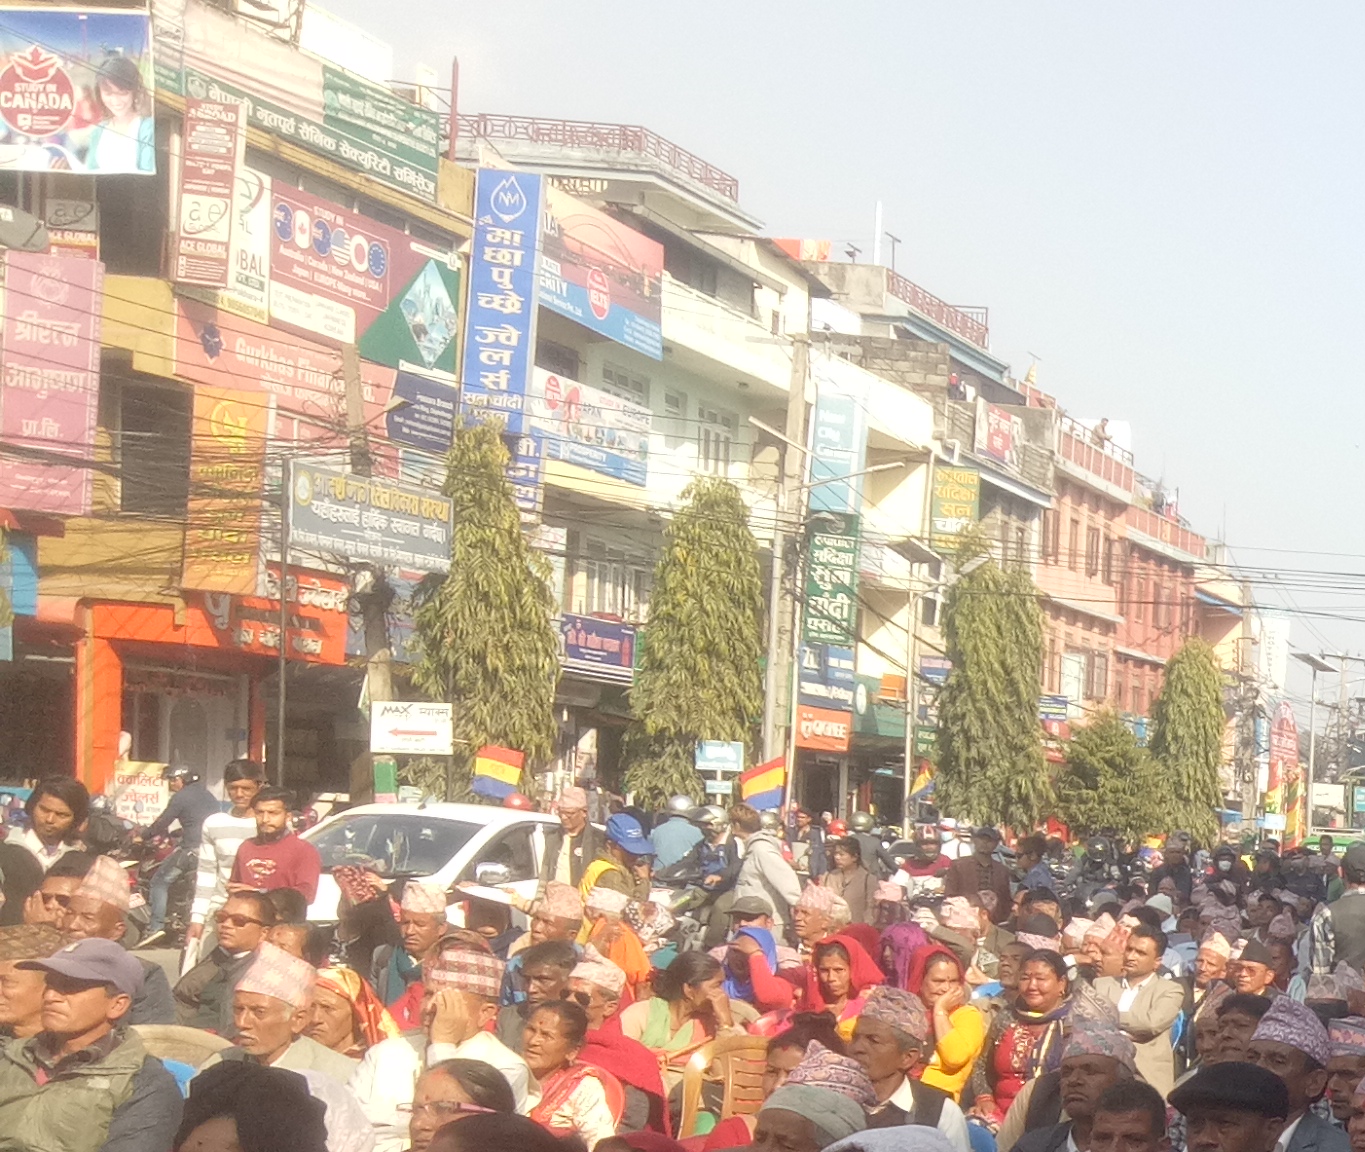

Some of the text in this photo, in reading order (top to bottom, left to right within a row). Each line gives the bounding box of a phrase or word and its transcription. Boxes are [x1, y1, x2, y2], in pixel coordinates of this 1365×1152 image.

[14, 83, 57, 92] STUDY IN
[0, 92, 72, 109] CANADA
[187, 107, 236, 124] ABROAD
[298, 123, 337, 152] सैनिक
[180, 239, 226, 254] ACE GLOBAL
[237, 249, 267, 278] BAL
[235, 336, 295, 378] Gurkhas
[380, 703, 414, 717] MAX
